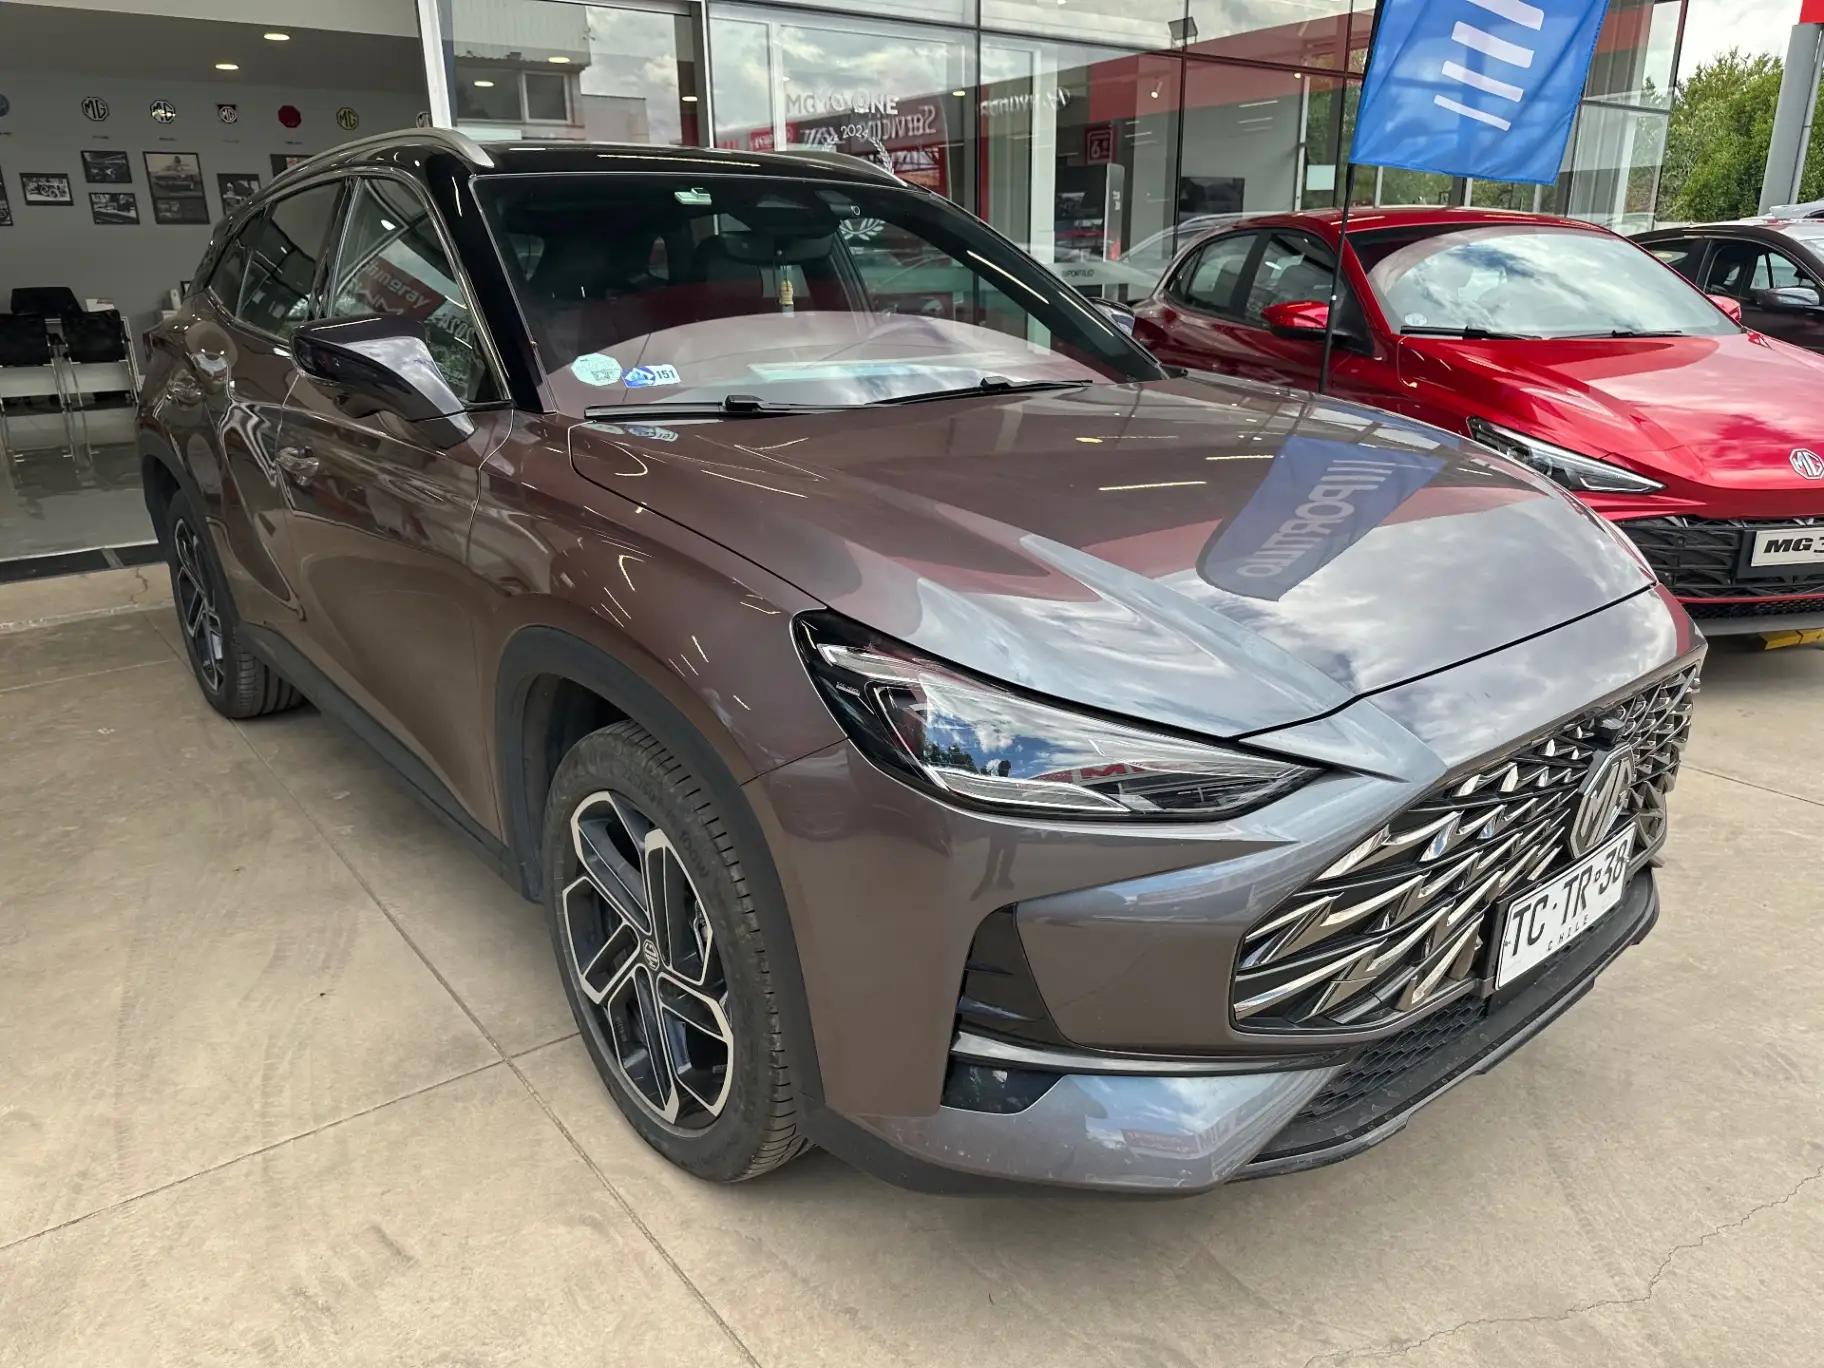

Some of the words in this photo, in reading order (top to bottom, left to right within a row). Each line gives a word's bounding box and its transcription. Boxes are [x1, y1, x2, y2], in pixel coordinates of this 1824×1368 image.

[83, 98, 108, 120] MG
[338, 108, 358, 129] MG
[361, 259, 432, 308] hineray
[656, 370, 676, 380] 151
[1791, 451, 1823, 477] MG
[1579, 756, 1633, 848] MG
[1547, 914, 1590, 951] CHILE
[643, 941, 659, 969] MG
